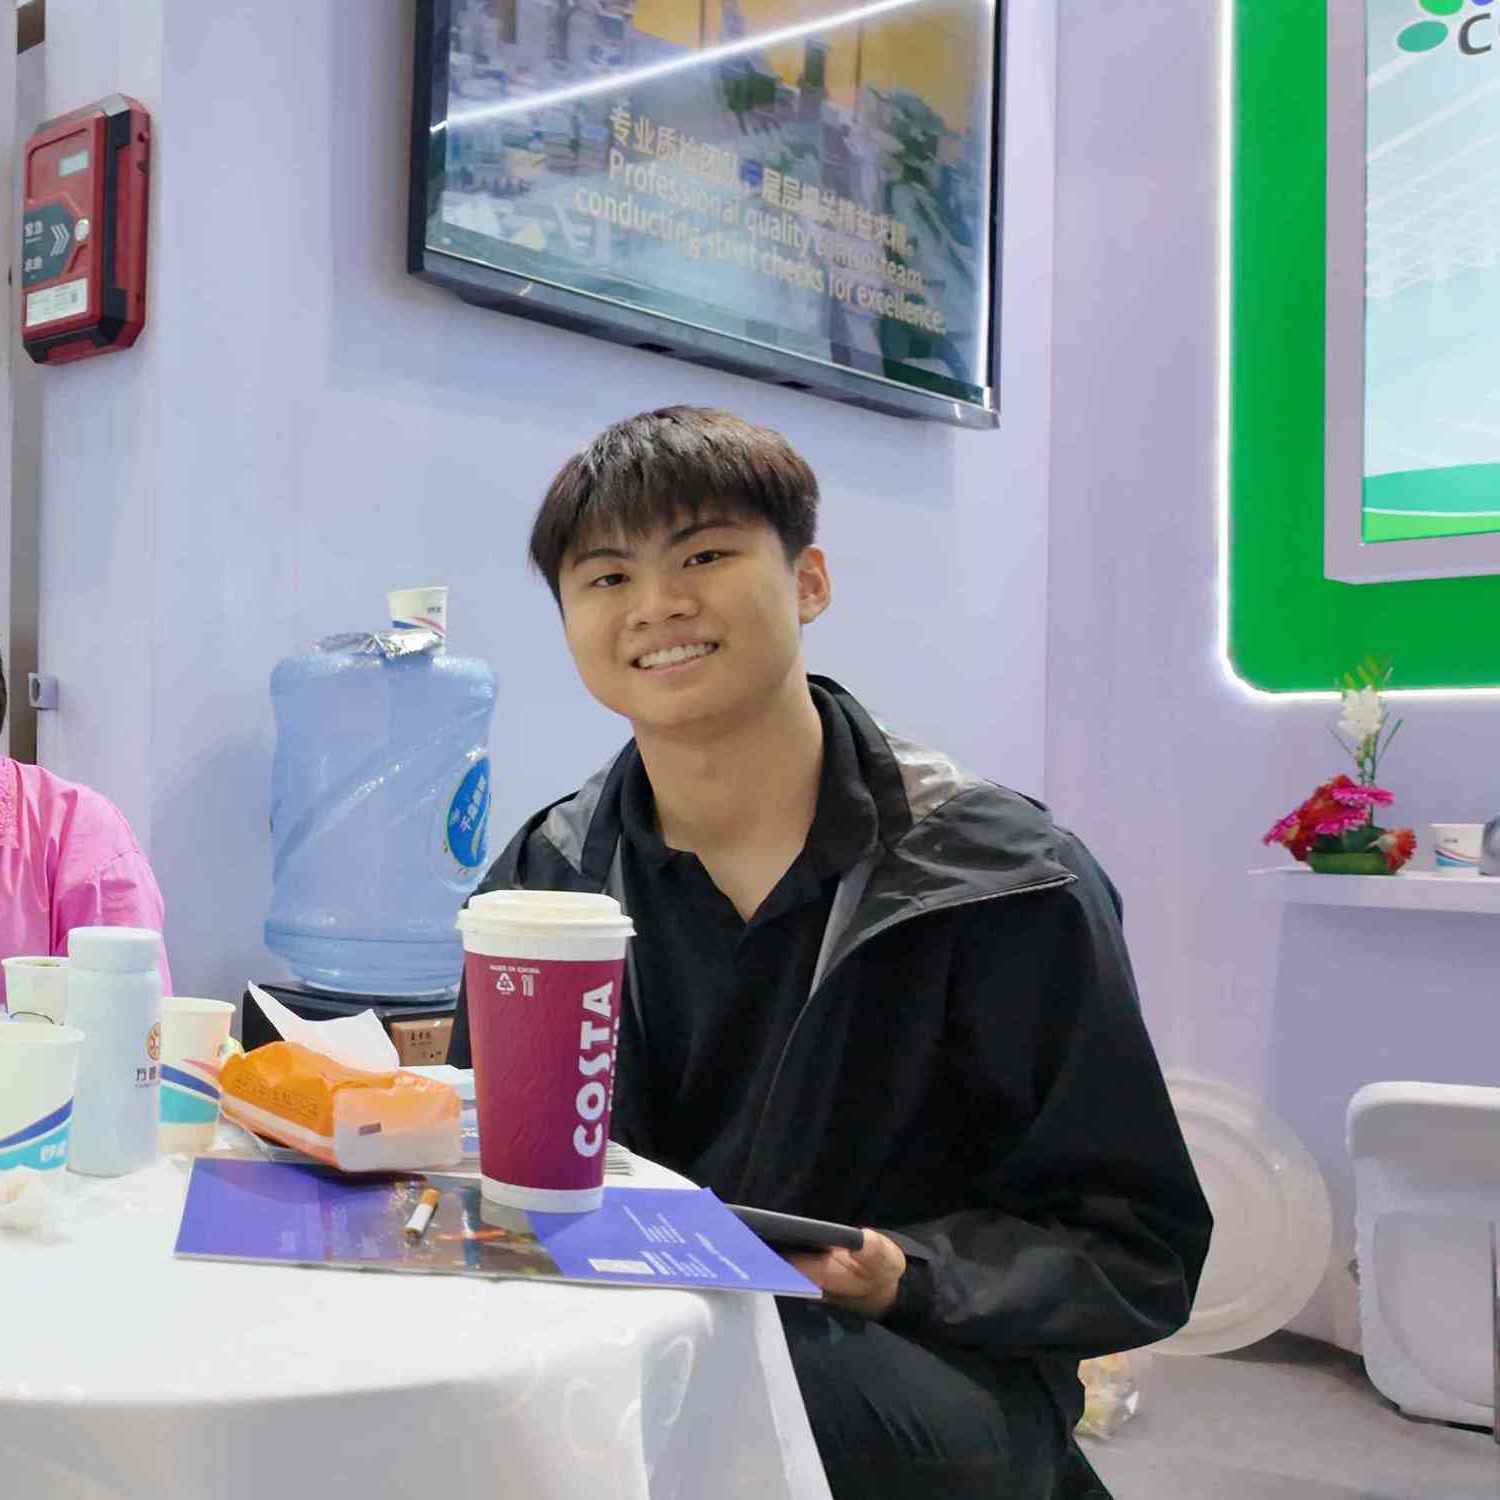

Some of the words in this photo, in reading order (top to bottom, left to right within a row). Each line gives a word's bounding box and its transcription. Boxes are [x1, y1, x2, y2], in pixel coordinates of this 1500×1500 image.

[573, 186, 701, 259] conducting
[828, 271, 854, 301] for
[609, 147, 741, 226] Professional
[747, 208, 817, 258] quality
[573, 981, 613, 1157] COSTA
